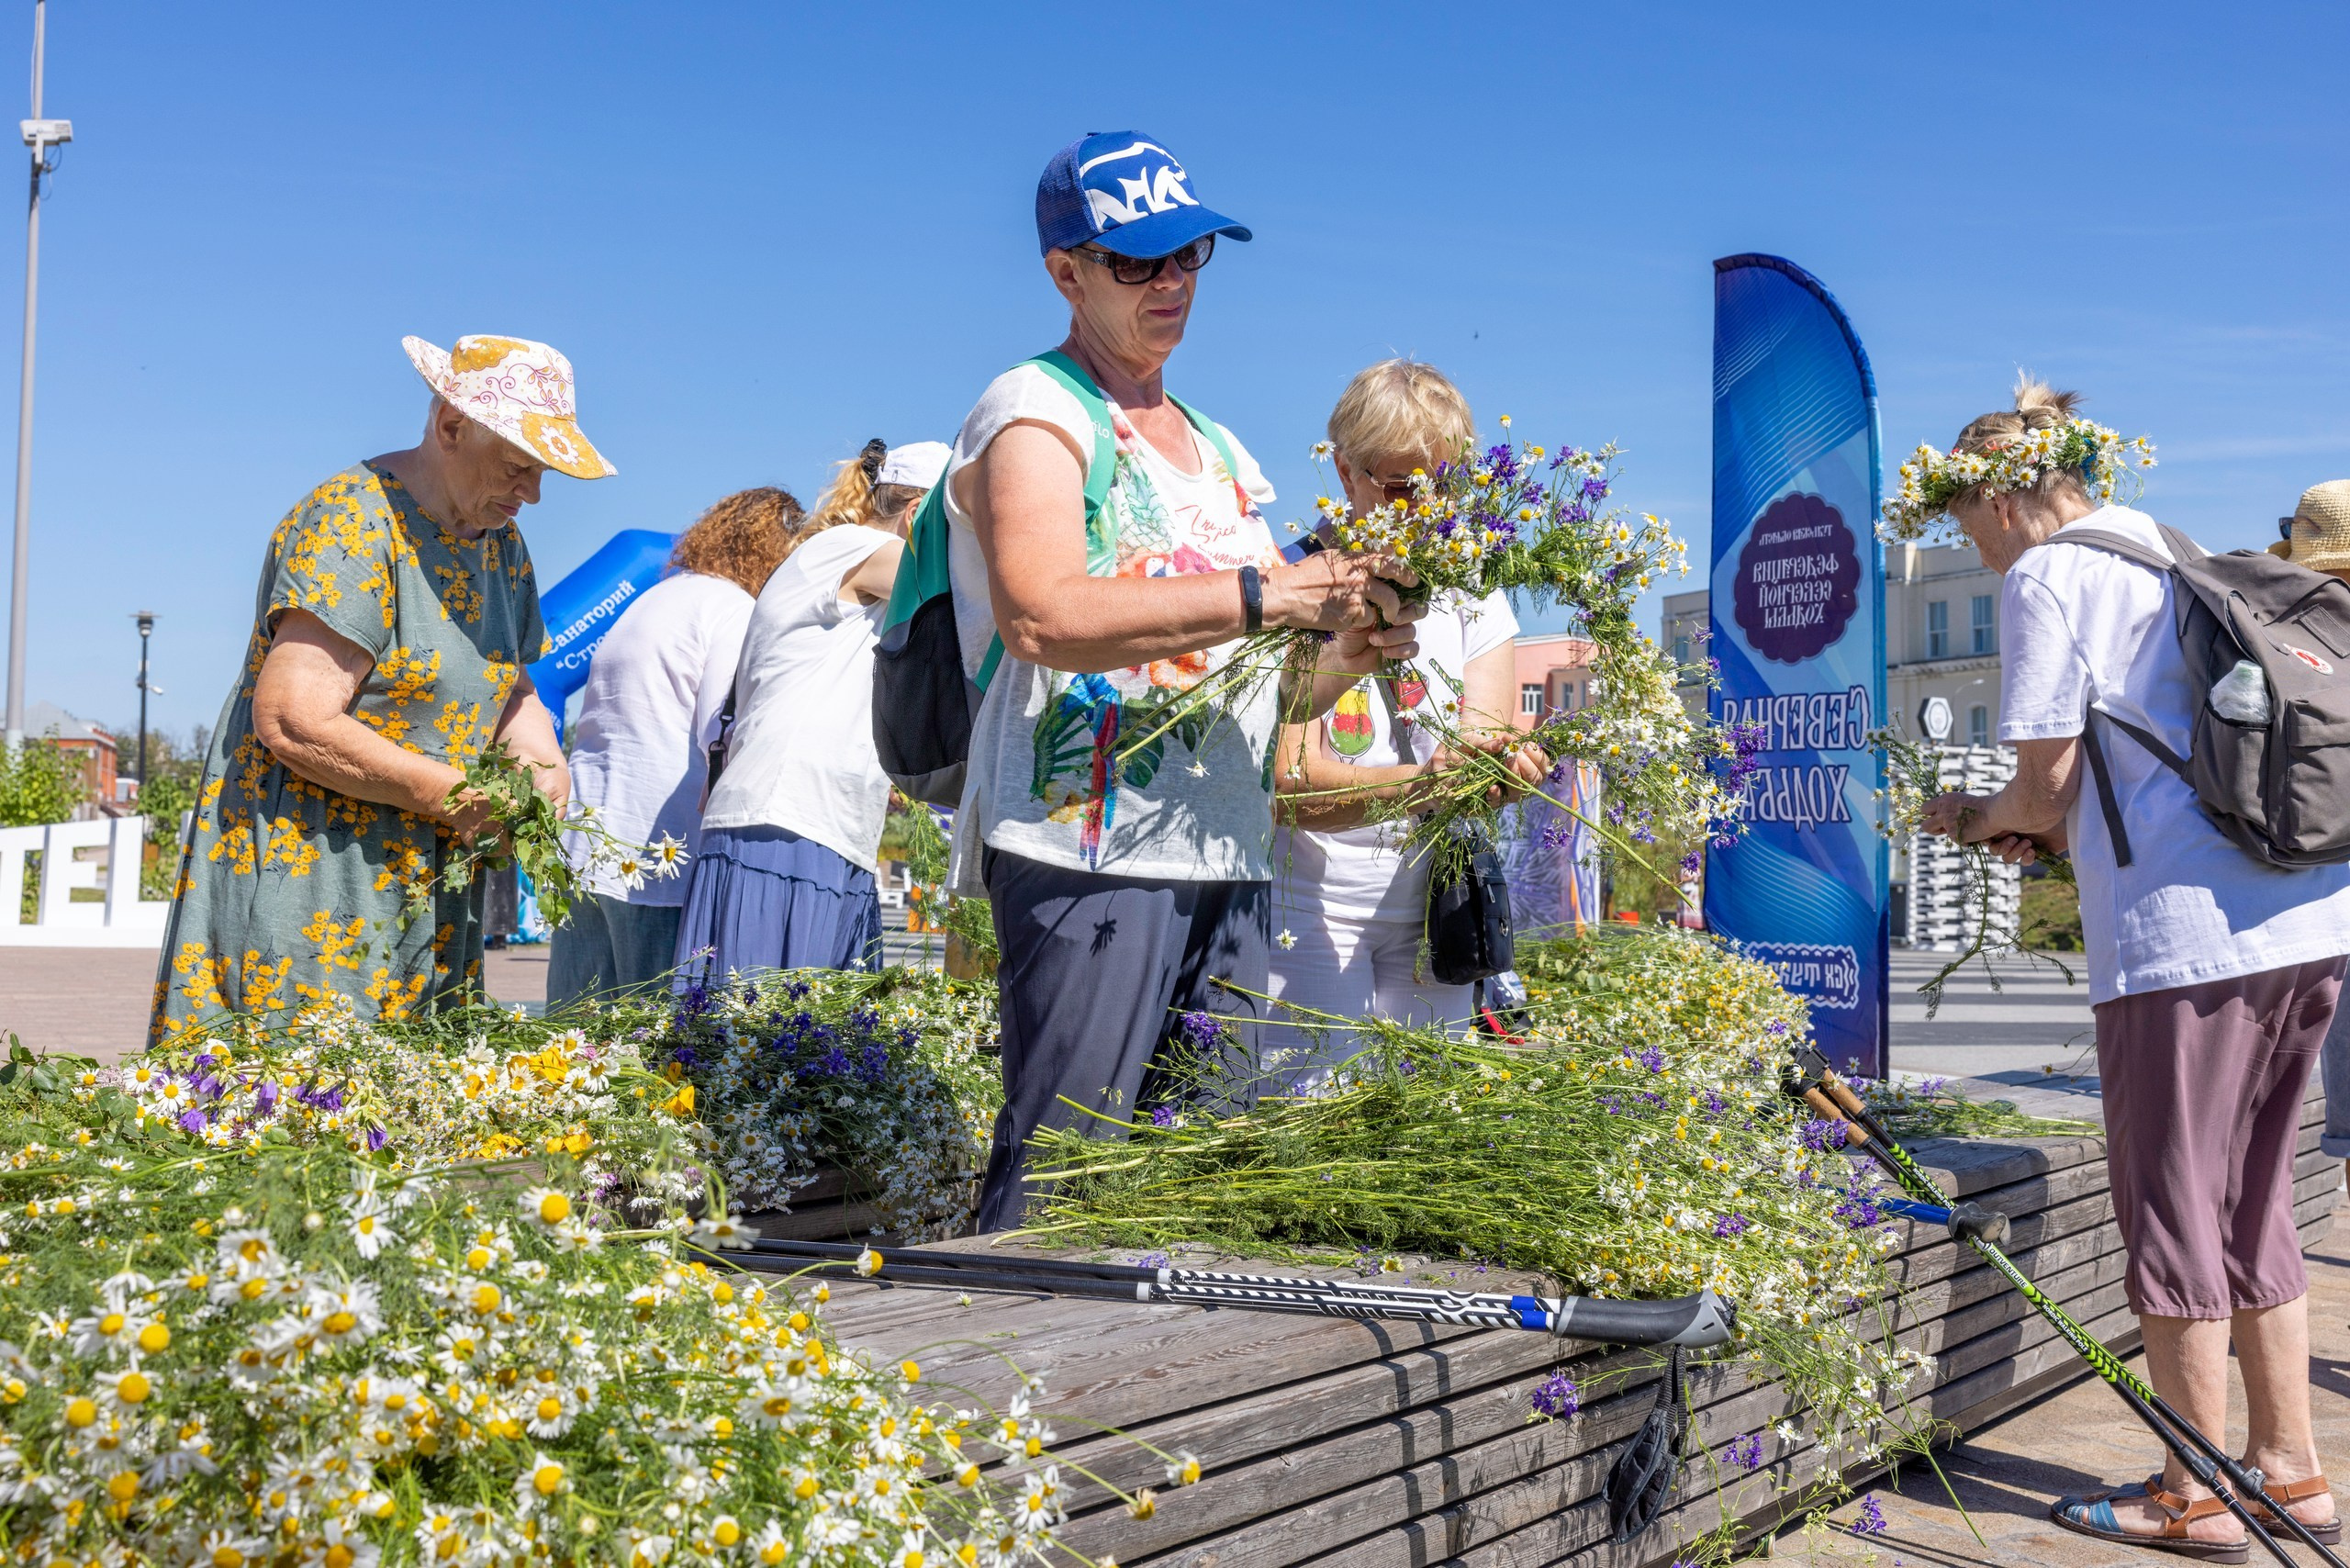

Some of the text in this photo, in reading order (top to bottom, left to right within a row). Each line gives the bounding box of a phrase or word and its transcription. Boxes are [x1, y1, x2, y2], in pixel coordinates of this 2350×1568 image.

[1912, 1168, 1929, 1184] NORDIC
[1927, 1182, 1945, 1201] WALKING
[1942, 1199, 1954, 1211] POLE
[1989, 1248, 2028, 1288] OUTVENTURE
[2042, 1304, 2088, 1352] NORDIC WALKING POLE
